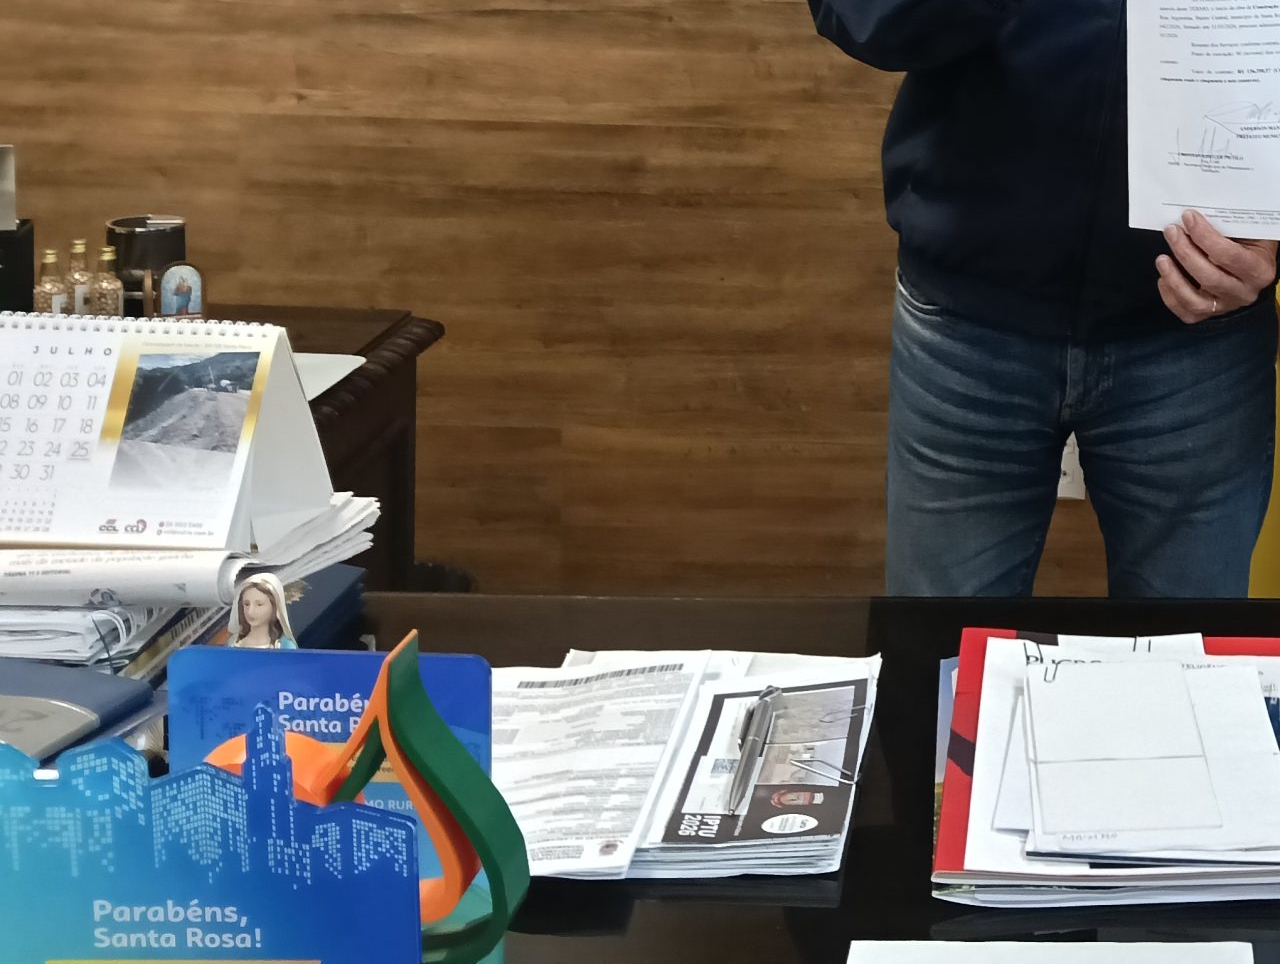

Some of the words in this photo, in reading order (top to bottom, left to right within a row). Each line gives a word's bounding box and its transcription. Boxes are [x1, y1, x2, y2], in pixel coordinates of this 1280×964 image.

[7, 370, 24, 386] 01
[33, 372, 53, 387] 02
[60, 372, 80, 388] 03
[87, 372, 107, 388] 04
[0, 393, 20, 409] 08
[27, 394, 48, 410] 09
[57, 395, 72, 410] 10
[87, 395, 97, 410] 11
[25, 418, 39, 433] 16
[52, 418, 66, 433] 17
[80, 418, 94, 434] 18
[0, 440, 8, 456] 2
[16, 440, 36, 456] 23
[43, 441, 62, 457] 24
[71, 441, 90, 457] 25
[9, 464, 30, 480] 30
[39, 464, 55, 481] 31
[278, 691, 369, 712] Parabé
[278, 714, 342, 733] Santa
[387, 800, 414, 810] RUR
[678, 814, 702, 836] 2026
[698, 815, 722, 837] IPTU
[93, 899, 248, 927] Parabéns,
[93, 927, 176, 949] Santa
[186, 928, 262, 949] Rosa!
